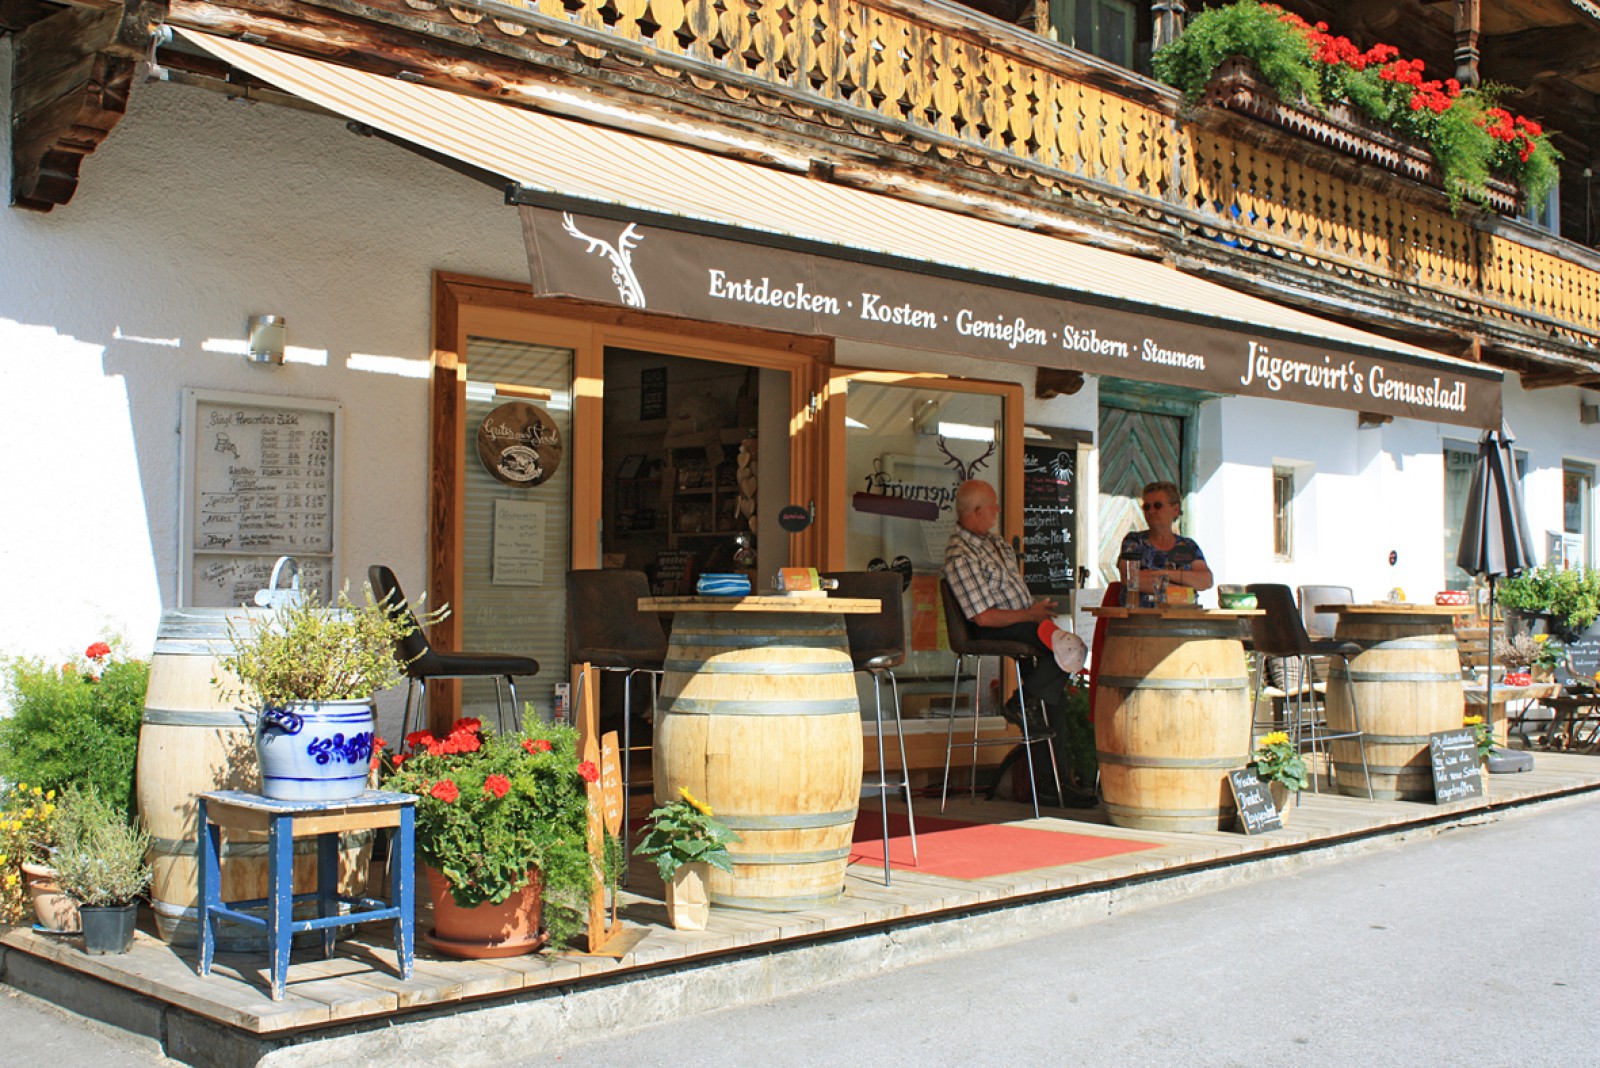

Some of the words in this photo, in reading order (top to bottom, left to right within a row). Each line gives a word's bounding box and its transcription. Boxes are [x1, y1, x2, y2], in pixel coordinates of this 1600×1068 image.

[708, 268, 841, 316] Entdecken
[860, 292, 938, 329] Kosten
[955, 309, 1048, 349] Genießen
[1062, 324, 1129, 358] Stöbern
[1141, 338, 1206, 371] Staunen
[1369, 365, 1467, 412] Genussladl
